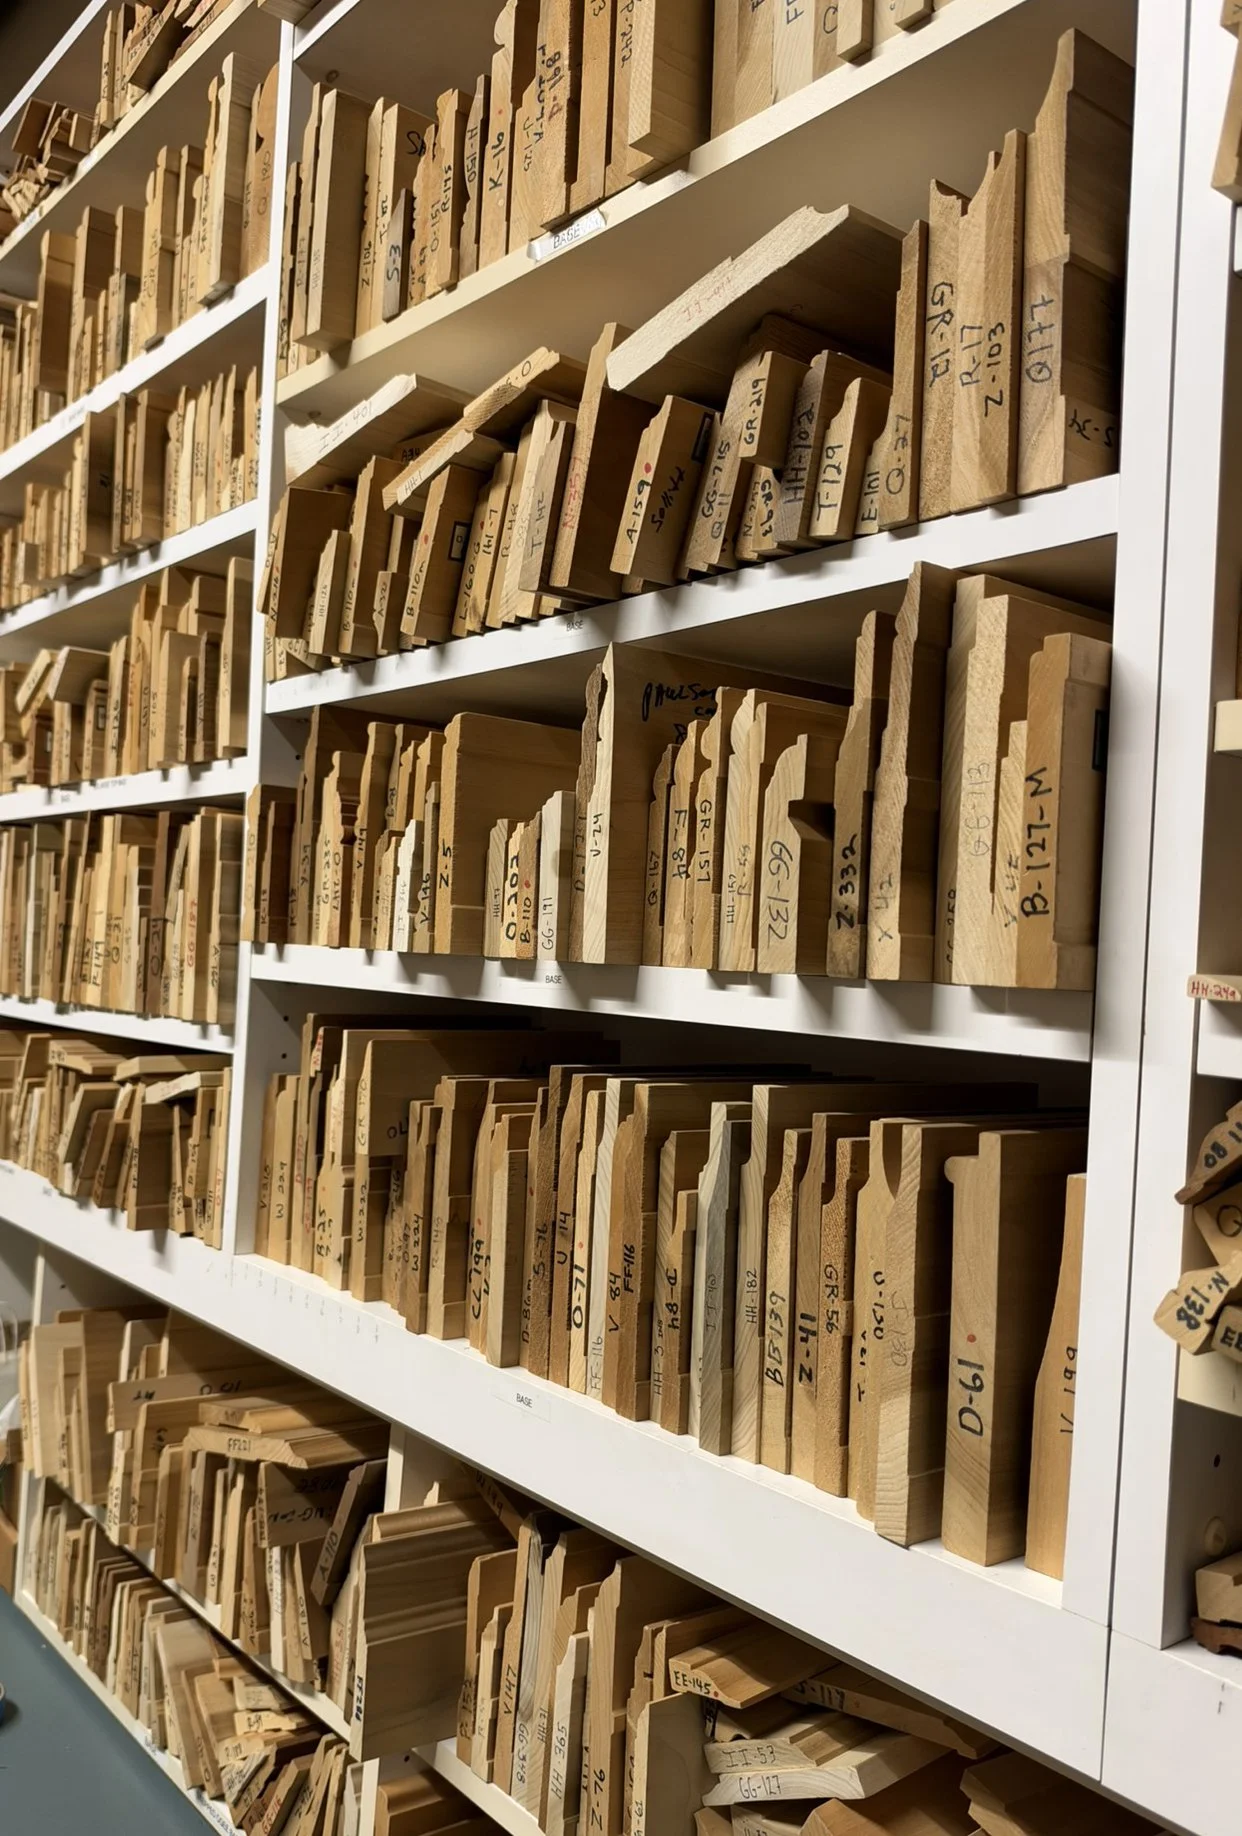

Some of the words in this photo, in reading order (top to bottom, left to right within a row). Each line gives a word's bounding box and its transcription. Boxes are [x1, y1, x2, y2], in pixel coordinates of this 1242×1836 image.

[488, 131, 506, 191] K-16
[386, 244, 401, 282] S-3
[959, 325, 984, 387] R-17
[984, 322, 1005, 417] Z-103
[626, 479, 652, 545] A-159
[566, 620, 584, 631] BASE
[699, 800, 712, 882] GR-157
[1020, 766, 1054, 919] B-127-M
[519, 896, 532, 945] B-110
[766, 840, 794, 942] GG-132
[541, 896, 554, 951] GG-191
[545, 974, 563, 985] BASE
[573, 1263, 587, 1330] O-71
[747, 1267, 758, 1325] HH-182
[823, 1263, 840, 1336] GR-56
[799, 1311, 818, 1384] Z-41
[516, 1393, 533, 1409] BASE
[956, 1357, 985, 1439] D-61
[672, 1669, 712, 1695] EE-145
